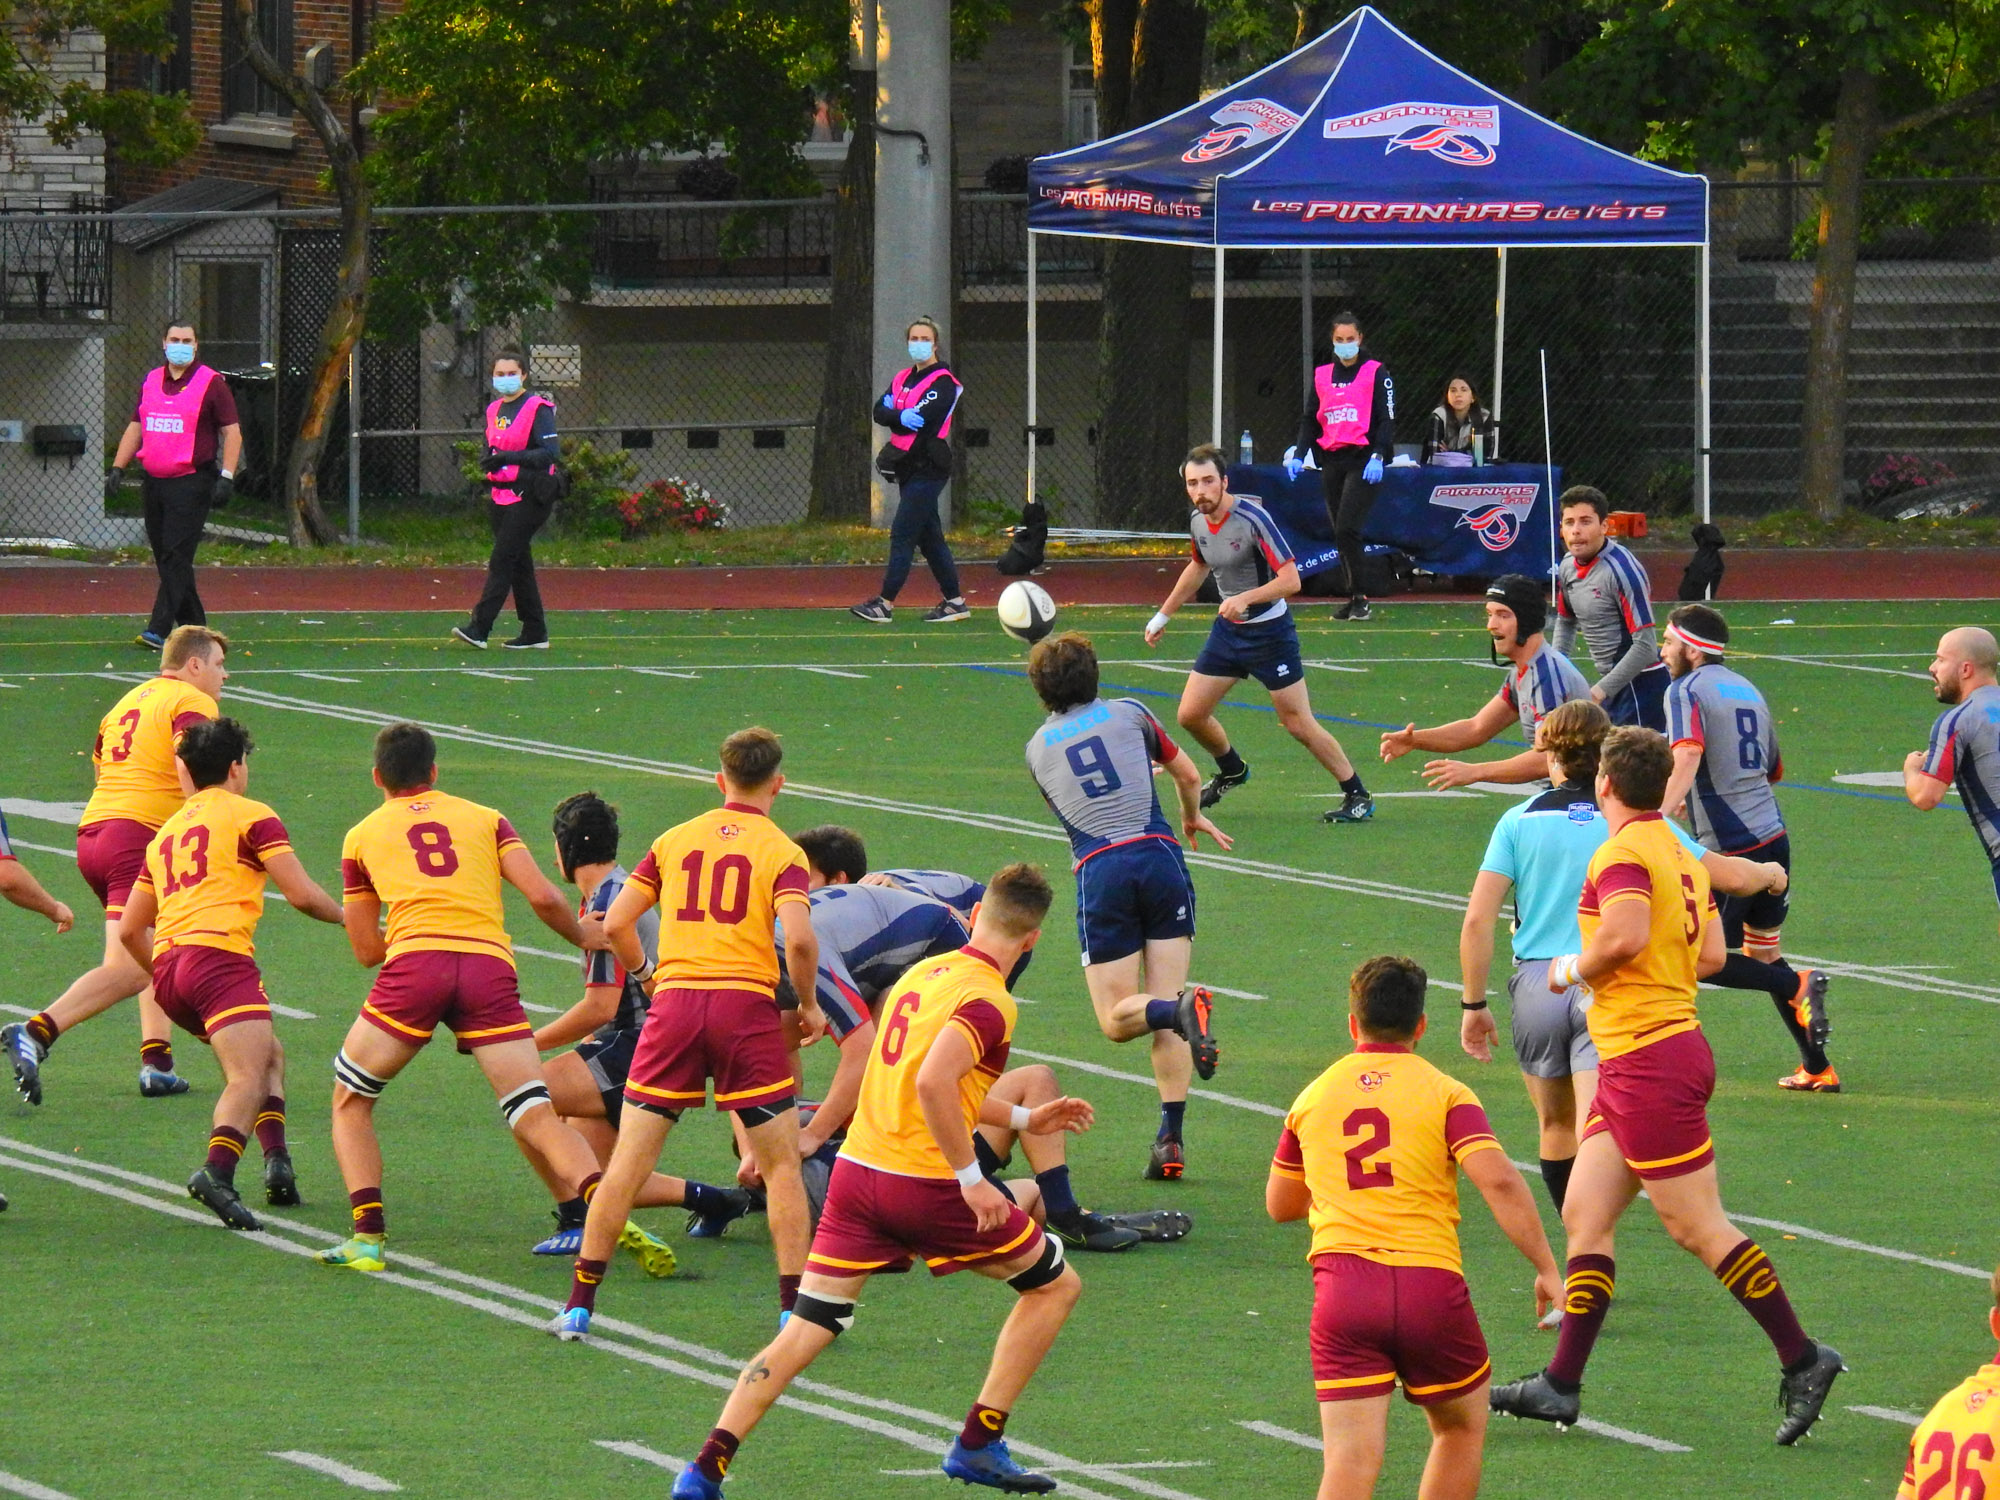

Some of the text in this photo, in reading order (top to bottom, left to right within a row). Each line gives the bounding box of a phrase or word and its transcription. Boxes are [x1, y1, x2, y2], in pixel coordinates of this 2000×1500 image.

[1330, 105, 1493, 132] PIRANHAS
[1039, 186, 1061, 199] Les
[1060, 190, 1153, 214] PIRANHAS
[1153, 201, 1167, 215] de
[1252, 199, 1302, 212] Les
[1302, 200, 1545, 223] PIRANHAS
[1544, 207, 1581, 220] de
[146, 416, 184, 434] RSEQ
[1324, 407, 1359, 425] RSEQ
[1435, 486, 1535, 497] PIRANHAS
[1305, 558, 1318, 569] de
[111, 709, 141, 761] 3
[1042, 706, 1112, 748] RSEQ
[1735, 708, 1762, 770] 8
[1065, 735, 1122, 799] 9
[158, 824, 210, 898] 13
[406, 821, 459, 877] 8
[676, 850, 752, 925] 10
[1681, 873, 1700, 946] 5
[881, 990, 921, 1067] 6
[1342, 1106, 1395, 1191] 2
[1917, 1431, 1996, 1500] 26
